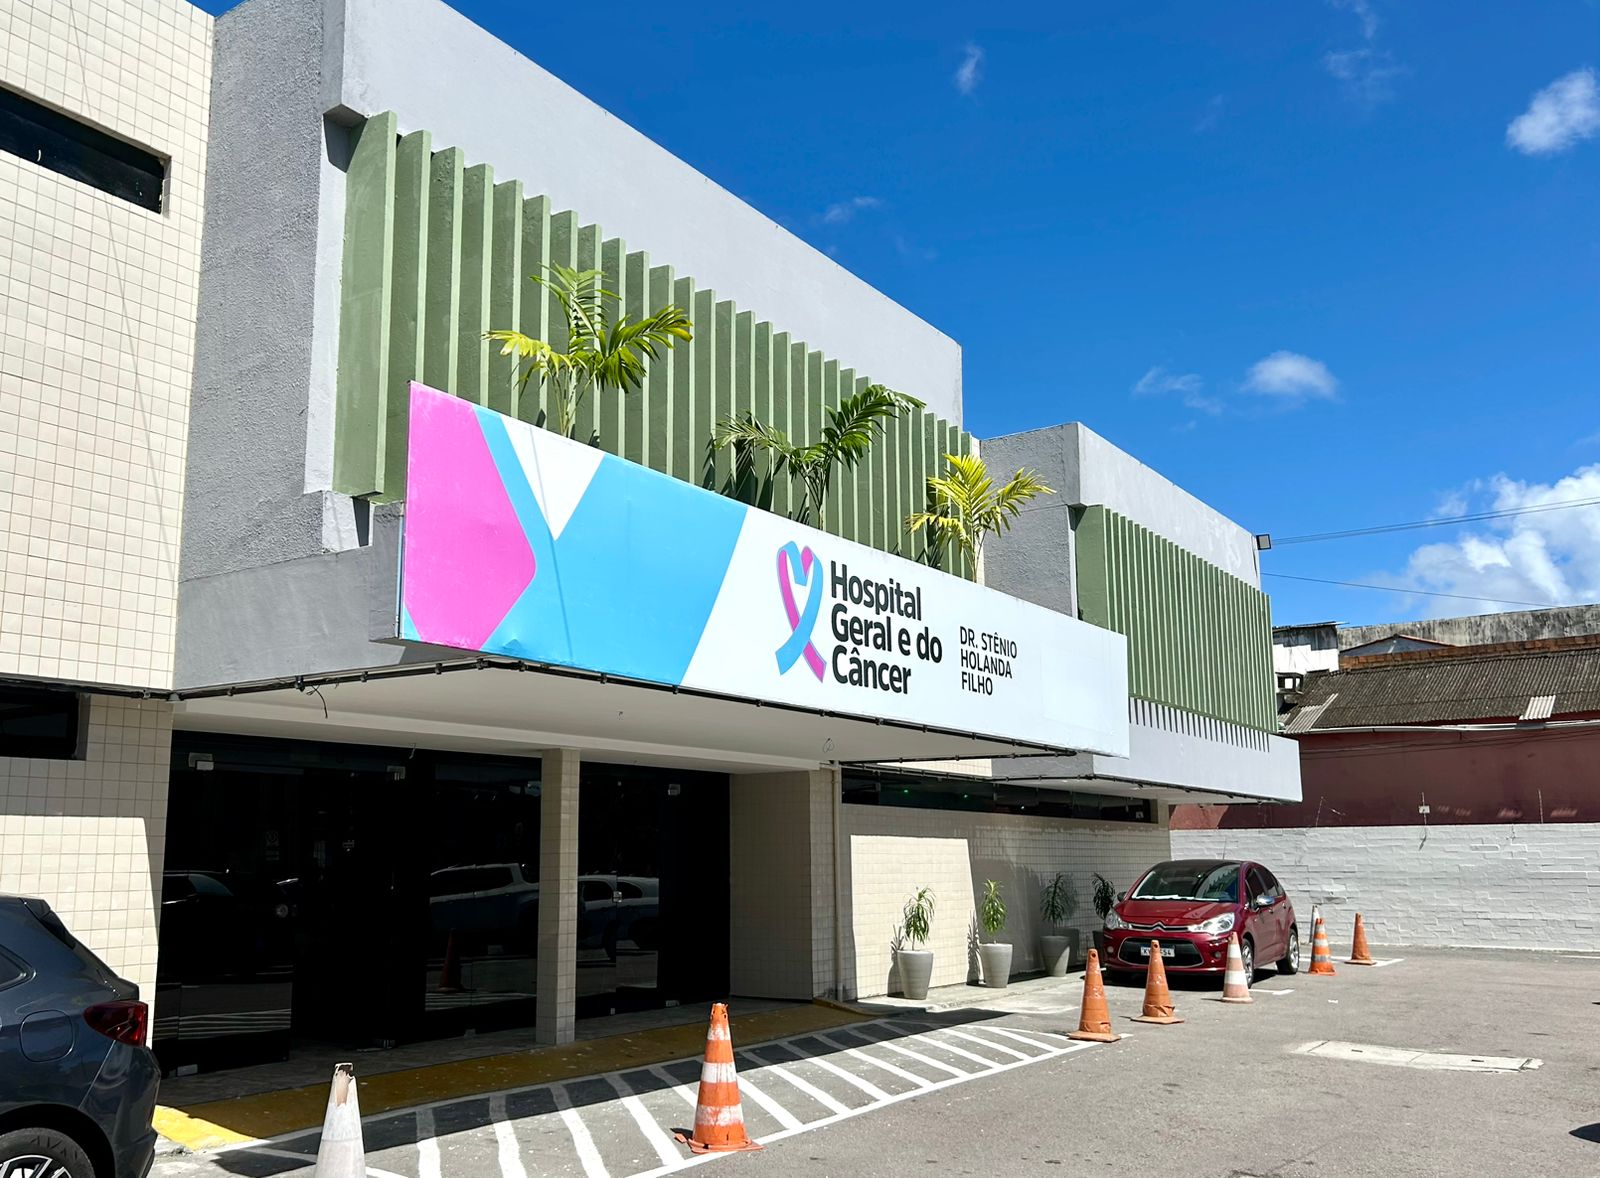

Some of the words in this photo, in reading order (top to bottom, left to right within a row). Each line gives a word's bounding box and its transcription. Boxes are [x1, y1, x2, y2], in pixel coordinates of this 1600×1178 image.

[831, 560, 922, 621] Hospital
[831, 603, 892, 652] Geral
[898, 627, 911, 657] e
[916, 626, 943, 663] do
[959, 625, 979, 649] DR.
[981, 632, 1018, 659] STÊNIO
[831, 645, 911, 694] Câncer
[960, 648, 1013, 679] HOLANDA
[961, 671, 994, 695] FILHO
